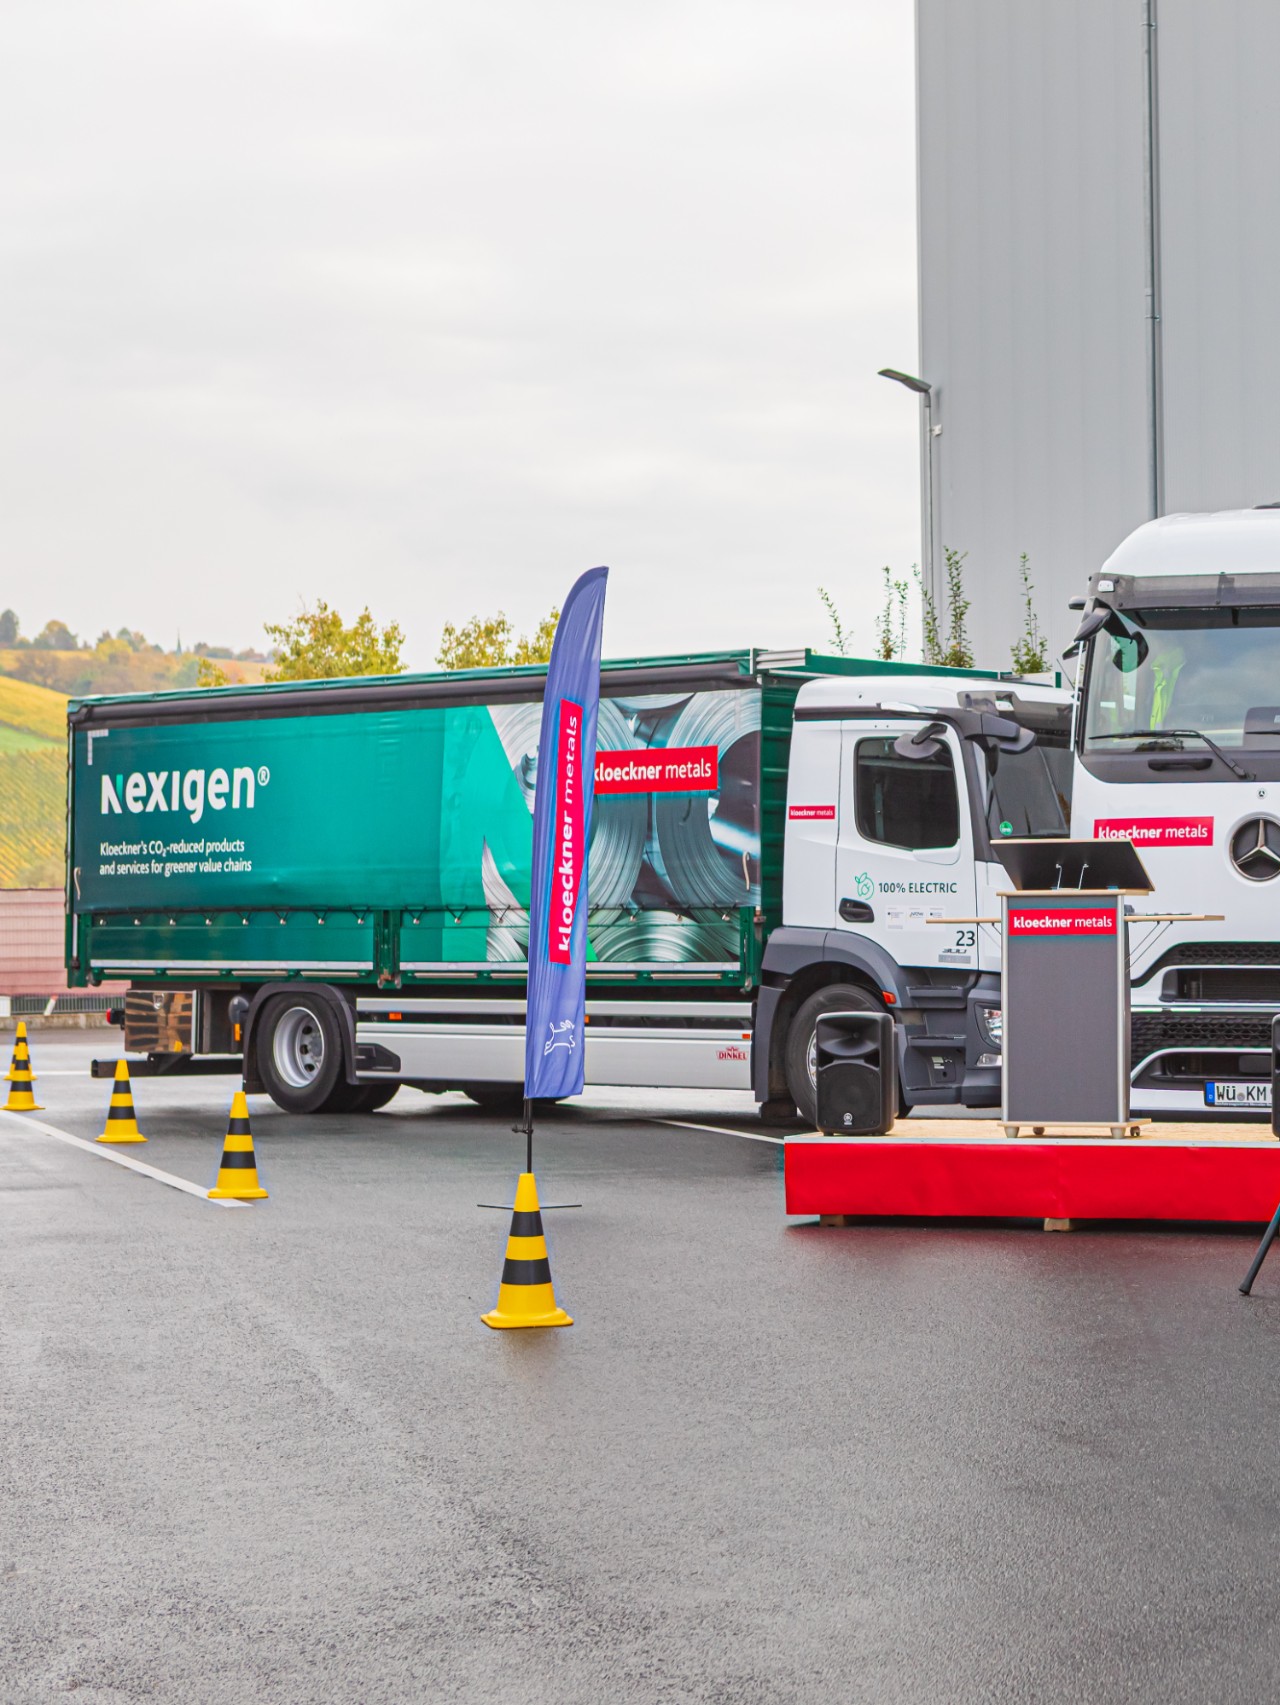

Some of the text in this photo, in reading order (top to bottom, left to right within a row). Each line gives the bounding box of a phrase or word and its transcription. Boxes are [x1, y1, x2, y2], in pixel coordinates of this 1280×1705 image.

[665, 758, 712, 779] metals
[790, 809, 816, 817] kloeckner
[558, 714, 578, 952] kloeckner metals
[1098, 824, 1208, 839] kloeckner metals
[100, 840, 148, 857] Kloeckner's
[205, 837, 245, 857] products
[99, 857, 252, 878] and services for greener value chains
[878, 882, 958, 894] 100% ELECTRIC
[1013, 914, 1113, 929] kloeckner metals
[955, 930, 976, 947] 23
[717, 1049, 748, 1060] DINKEL
[1246, 1085, 1267, 1101] KM
